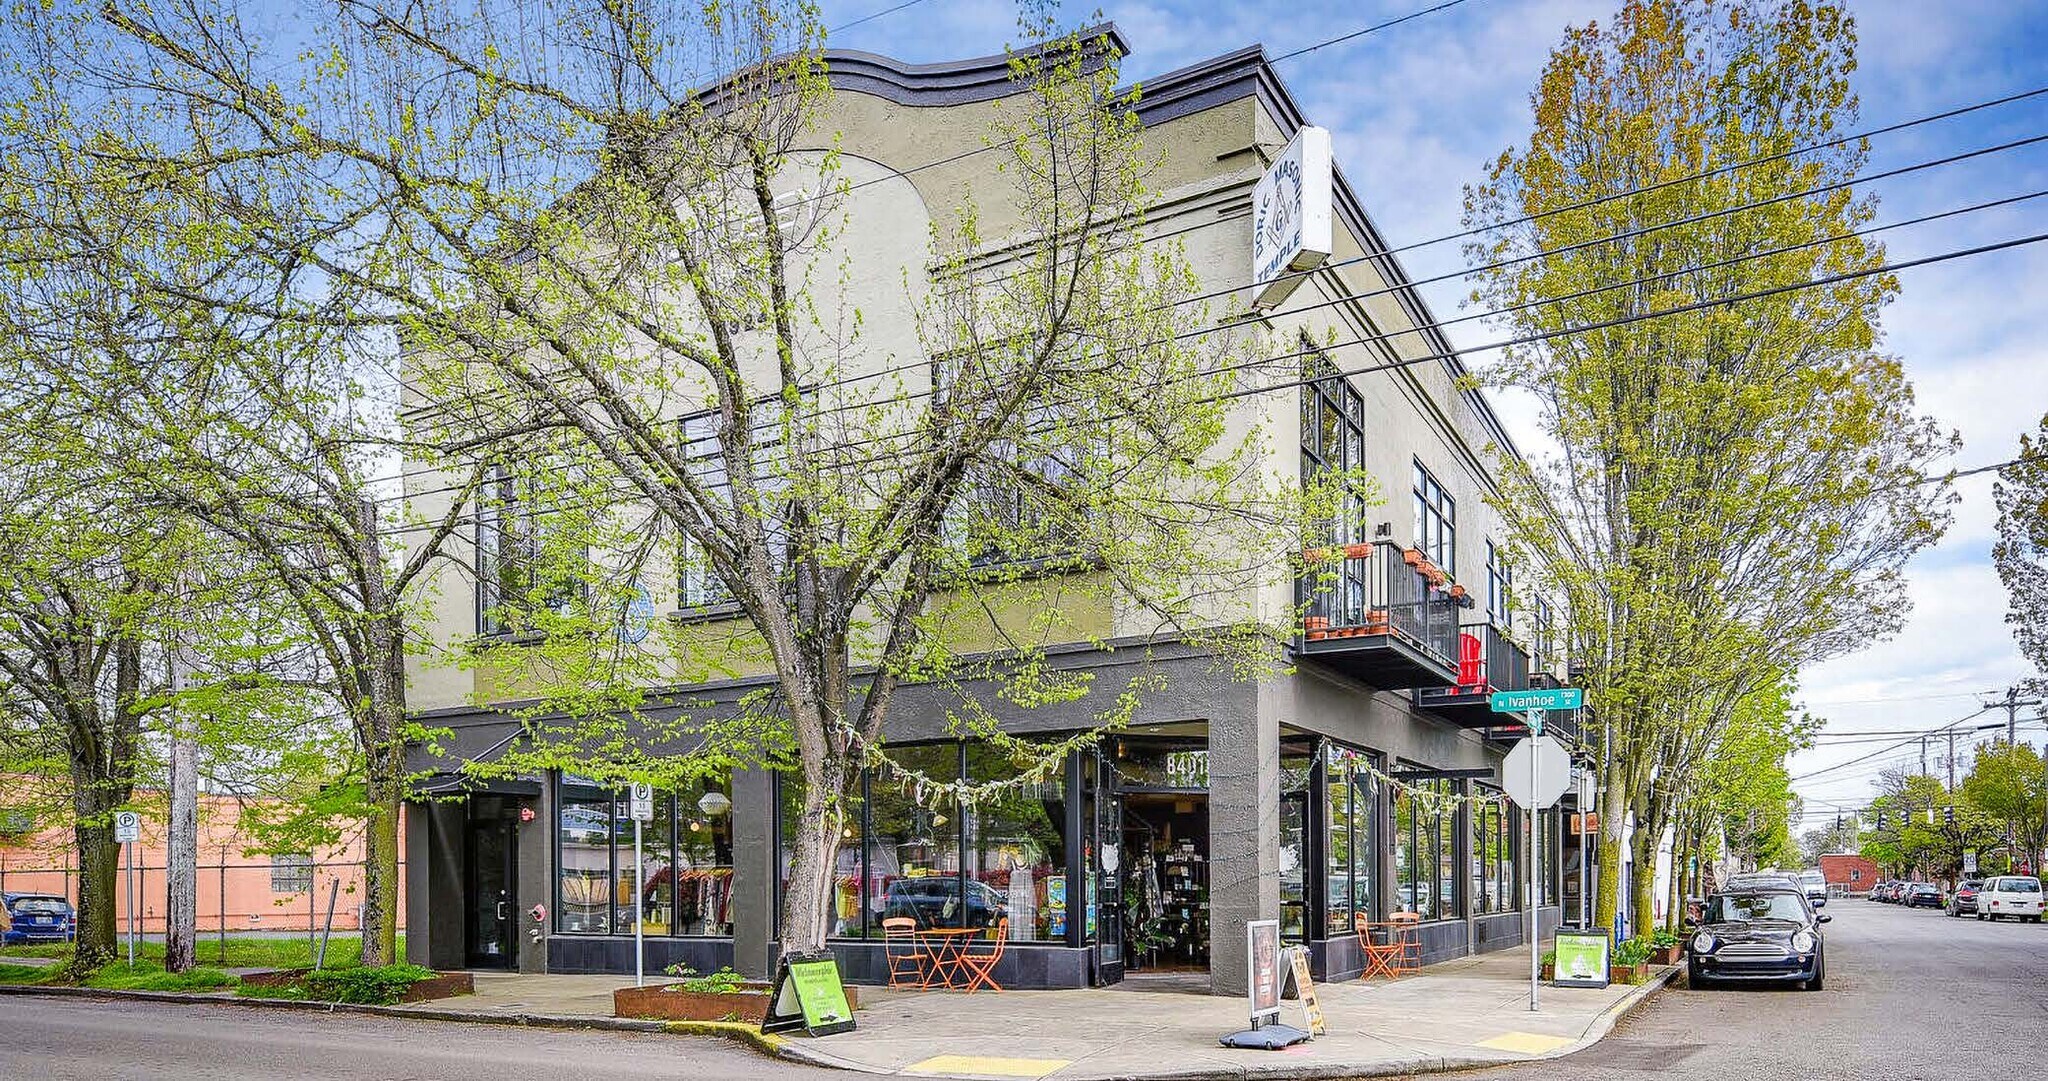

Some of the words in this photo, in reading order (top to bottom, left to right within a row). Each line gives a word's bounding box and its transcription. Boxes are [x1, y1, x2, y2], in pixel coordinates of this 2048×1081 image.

[1274, 160, 1302, 214] MASONIC
[1255, 193, 1271, 259] DORIC
[1275, 210, 1284, 232] G
[1257, 231, 1301, 284] TEMPLE
[1508, 695, 1555, 707] Ivanhoe
[124, 816, 132, 825] P
